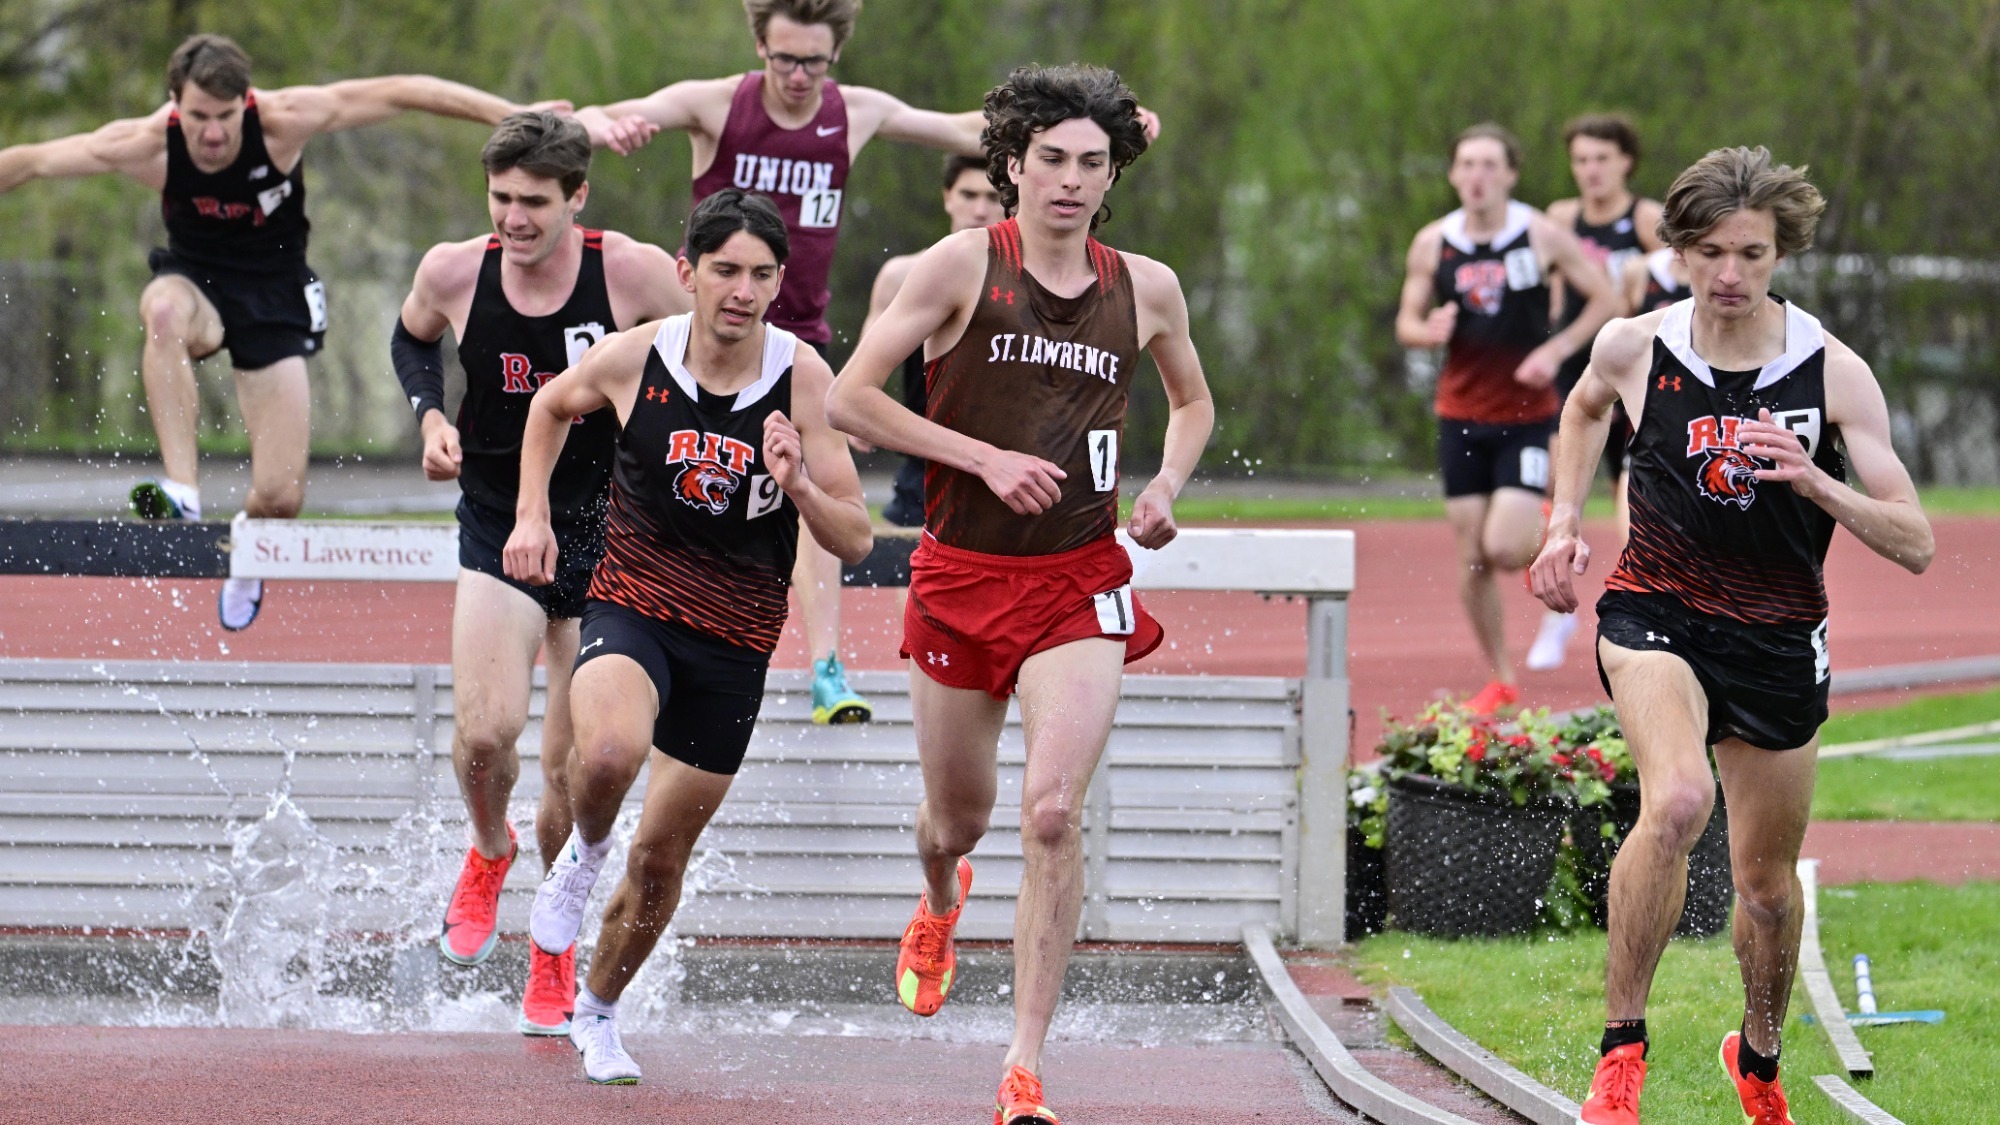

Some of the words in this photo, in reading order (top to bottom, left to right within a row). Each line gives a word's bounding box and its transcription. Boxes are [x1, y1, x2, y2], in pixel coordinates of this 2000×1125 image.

[733, 153, 834, 196] UNION
[813, 194, 836, 223] 12
[987, 334, 1016, 362] ST.
[1020, 334, 1119, 384] LAWRENCE
[665, 430, 755, 476] RIT
[1686, 415, 1770, 461] RI
[1096, 434, 1109, 488] 1
[757, 476, 780, 514] 9
[254, 537, 290, 562] St.
[303, 538, 433, 565] Lawrence
